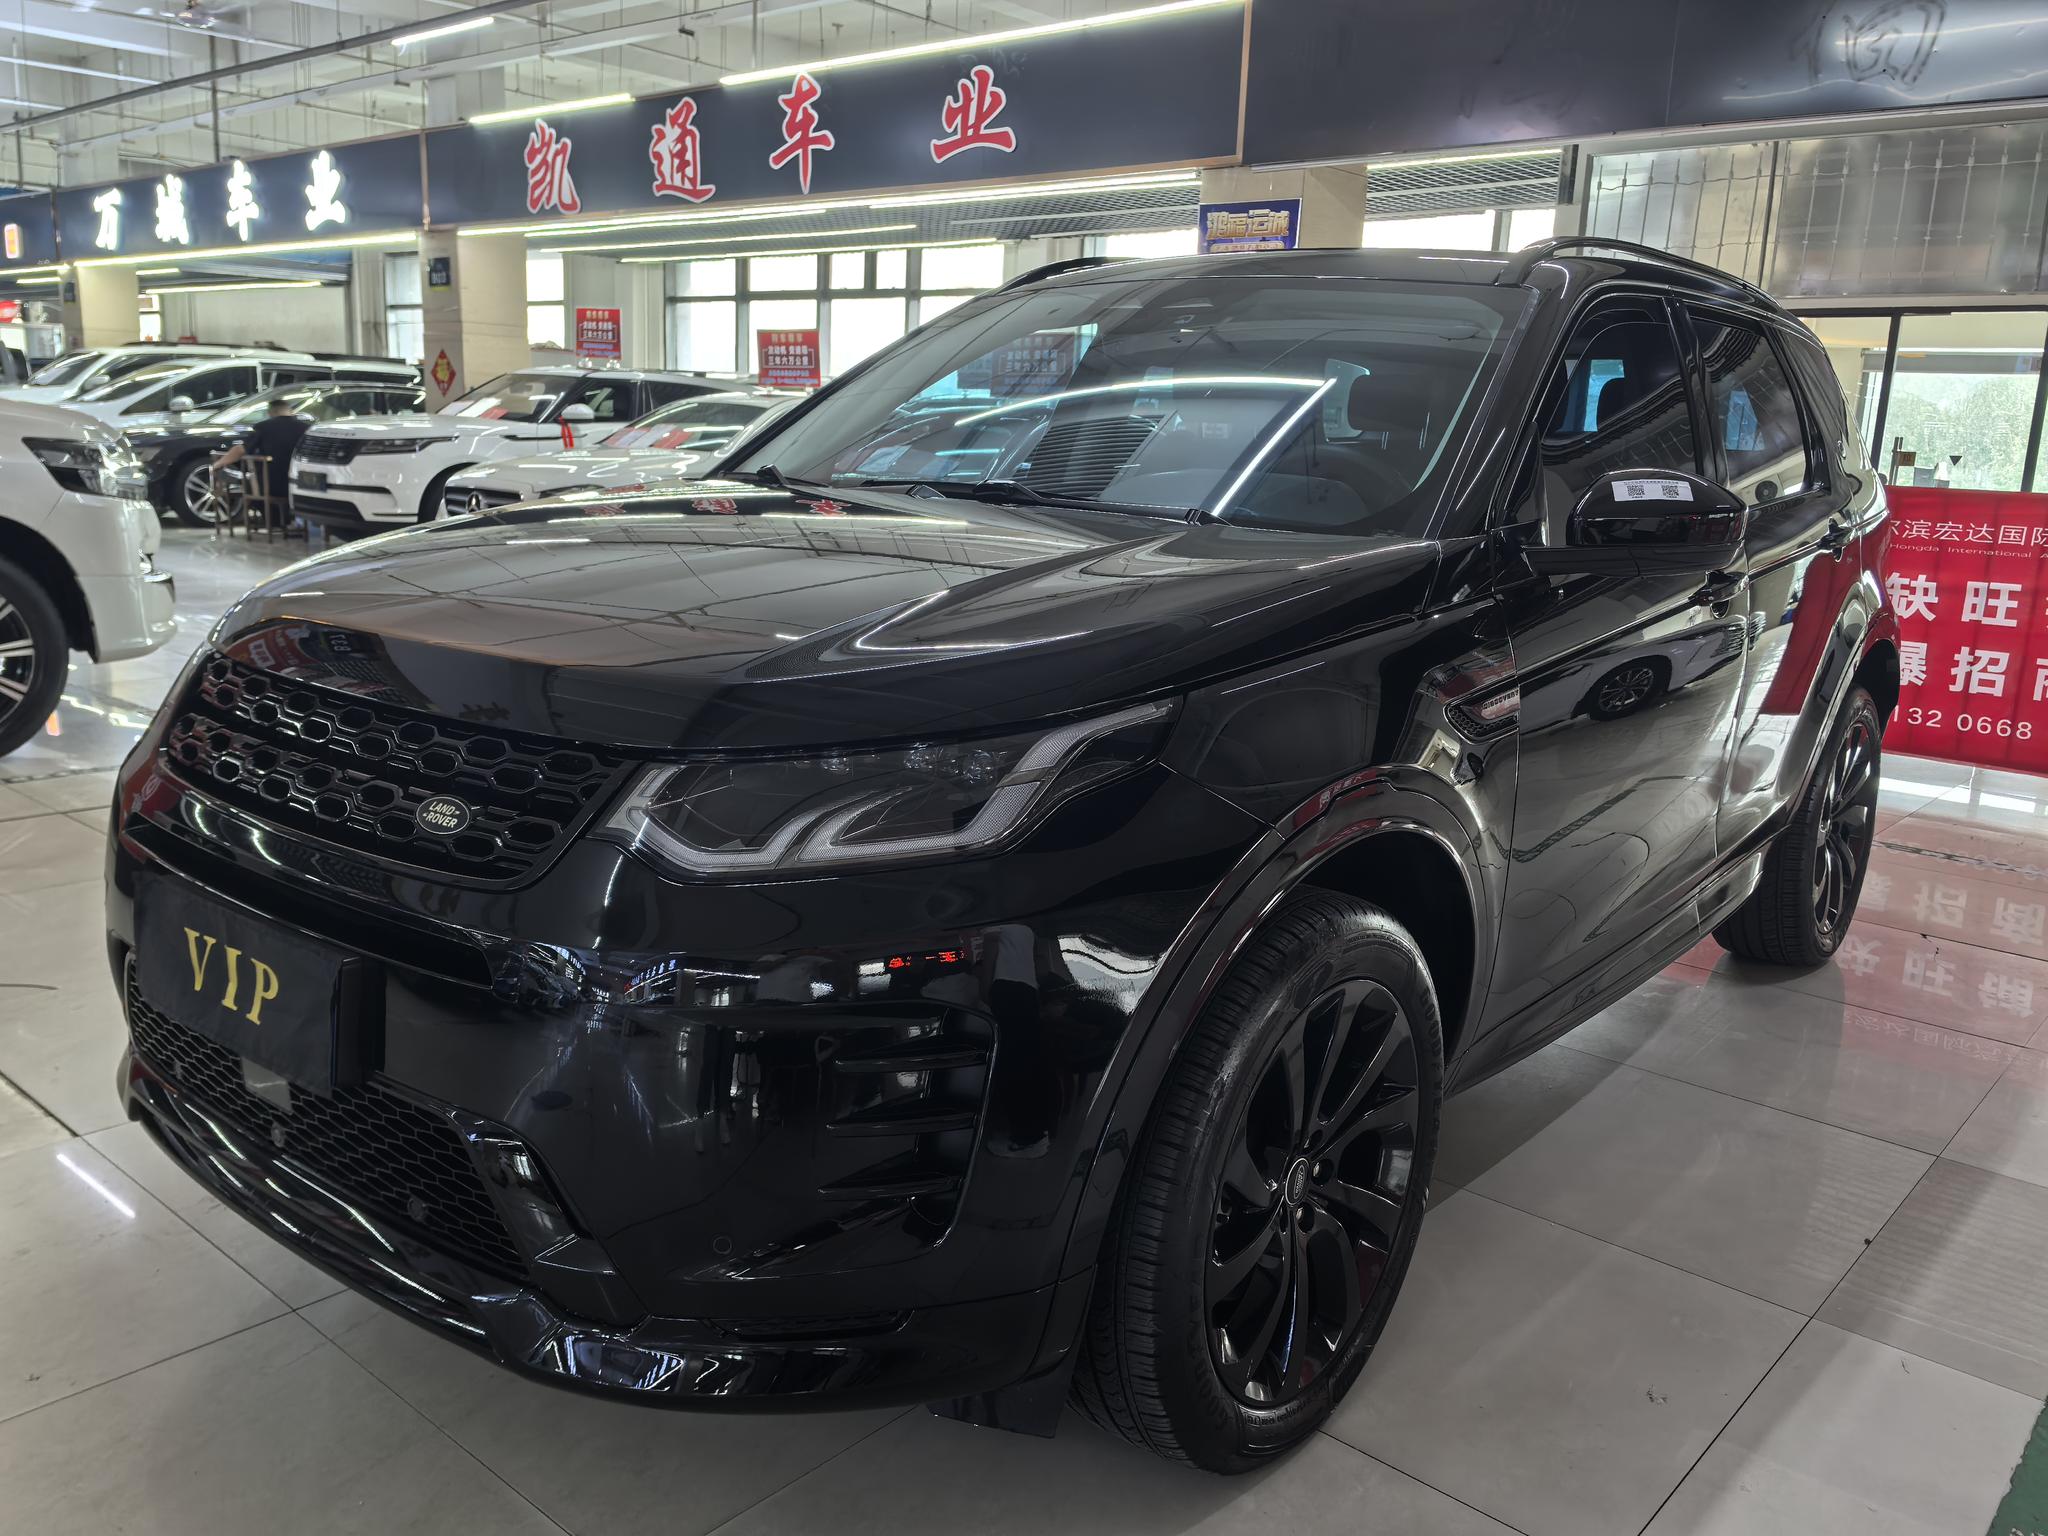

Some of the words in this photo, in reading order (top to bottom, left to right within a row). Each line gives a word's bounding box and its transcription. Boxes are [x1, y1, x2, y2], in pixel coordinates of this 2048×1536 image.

[524, 65, 1017, 214] 凯通车业
[1948, 547, 2032, 559] International
[1885, 572, 2048, 628] 缺旺
[1957, 713, 2032, 740] 0668
[425, 812, 458, 828] ROVER
[429, 801, 456, 815] LAND
[183, 926, 279, 1026] VIP
